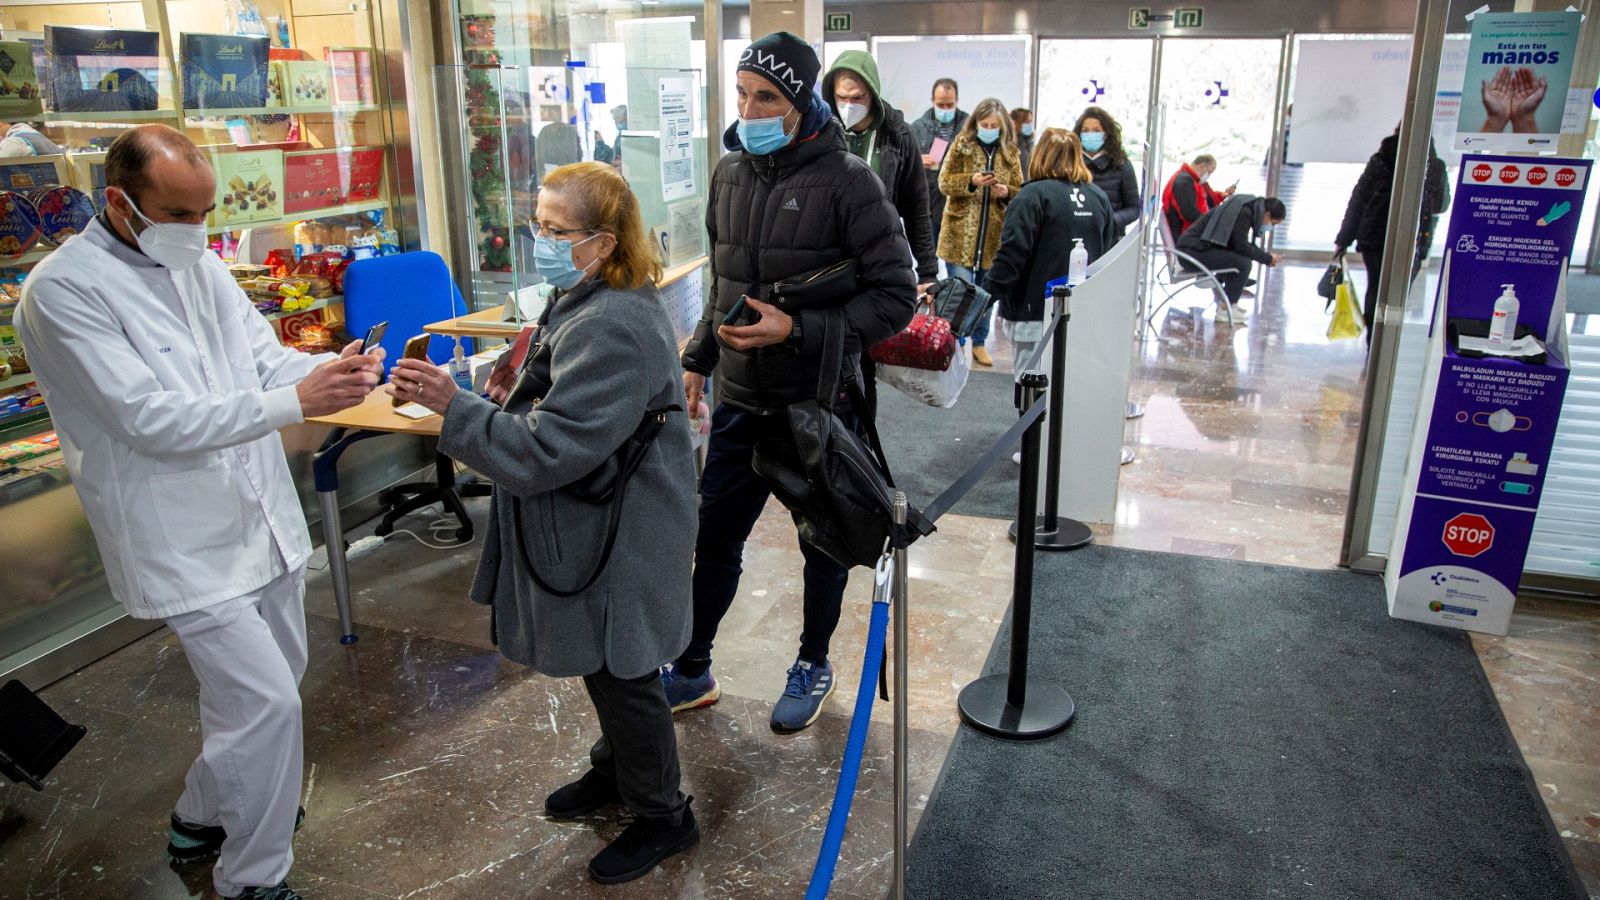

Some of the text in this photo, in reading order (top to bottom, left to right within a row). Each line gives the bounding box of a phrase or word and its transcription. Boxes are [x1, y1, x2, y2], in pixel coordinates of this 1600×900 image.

[1482, 51, 1560, 64] manos
[1528, 172, 1547, 180] STOP
[1556, 174, 1575, 182] STOP
[1470, 196, 1514, 205] ESKULARRUAK
[1452, 365, 1556, 381] BALBULADUN MASKARA BADUZU
[1473, 374, 1505, 383] MASKARIK
[1498, 385, 1538, 395] MASCARILLA
[1493, 391, 1532, 401] MASCARILLA
[1432, 446, 1502, 459] LEIHATILEAN MASKARA
[1436, 453, 1473, 462] KIRURGIKOA
[1429, 466, 1496, 480] SOLICITE MASCARILLA
[1442, 481, 1478, 490] VENTANILLA
[1448, 525, 1490, 544] STOP
